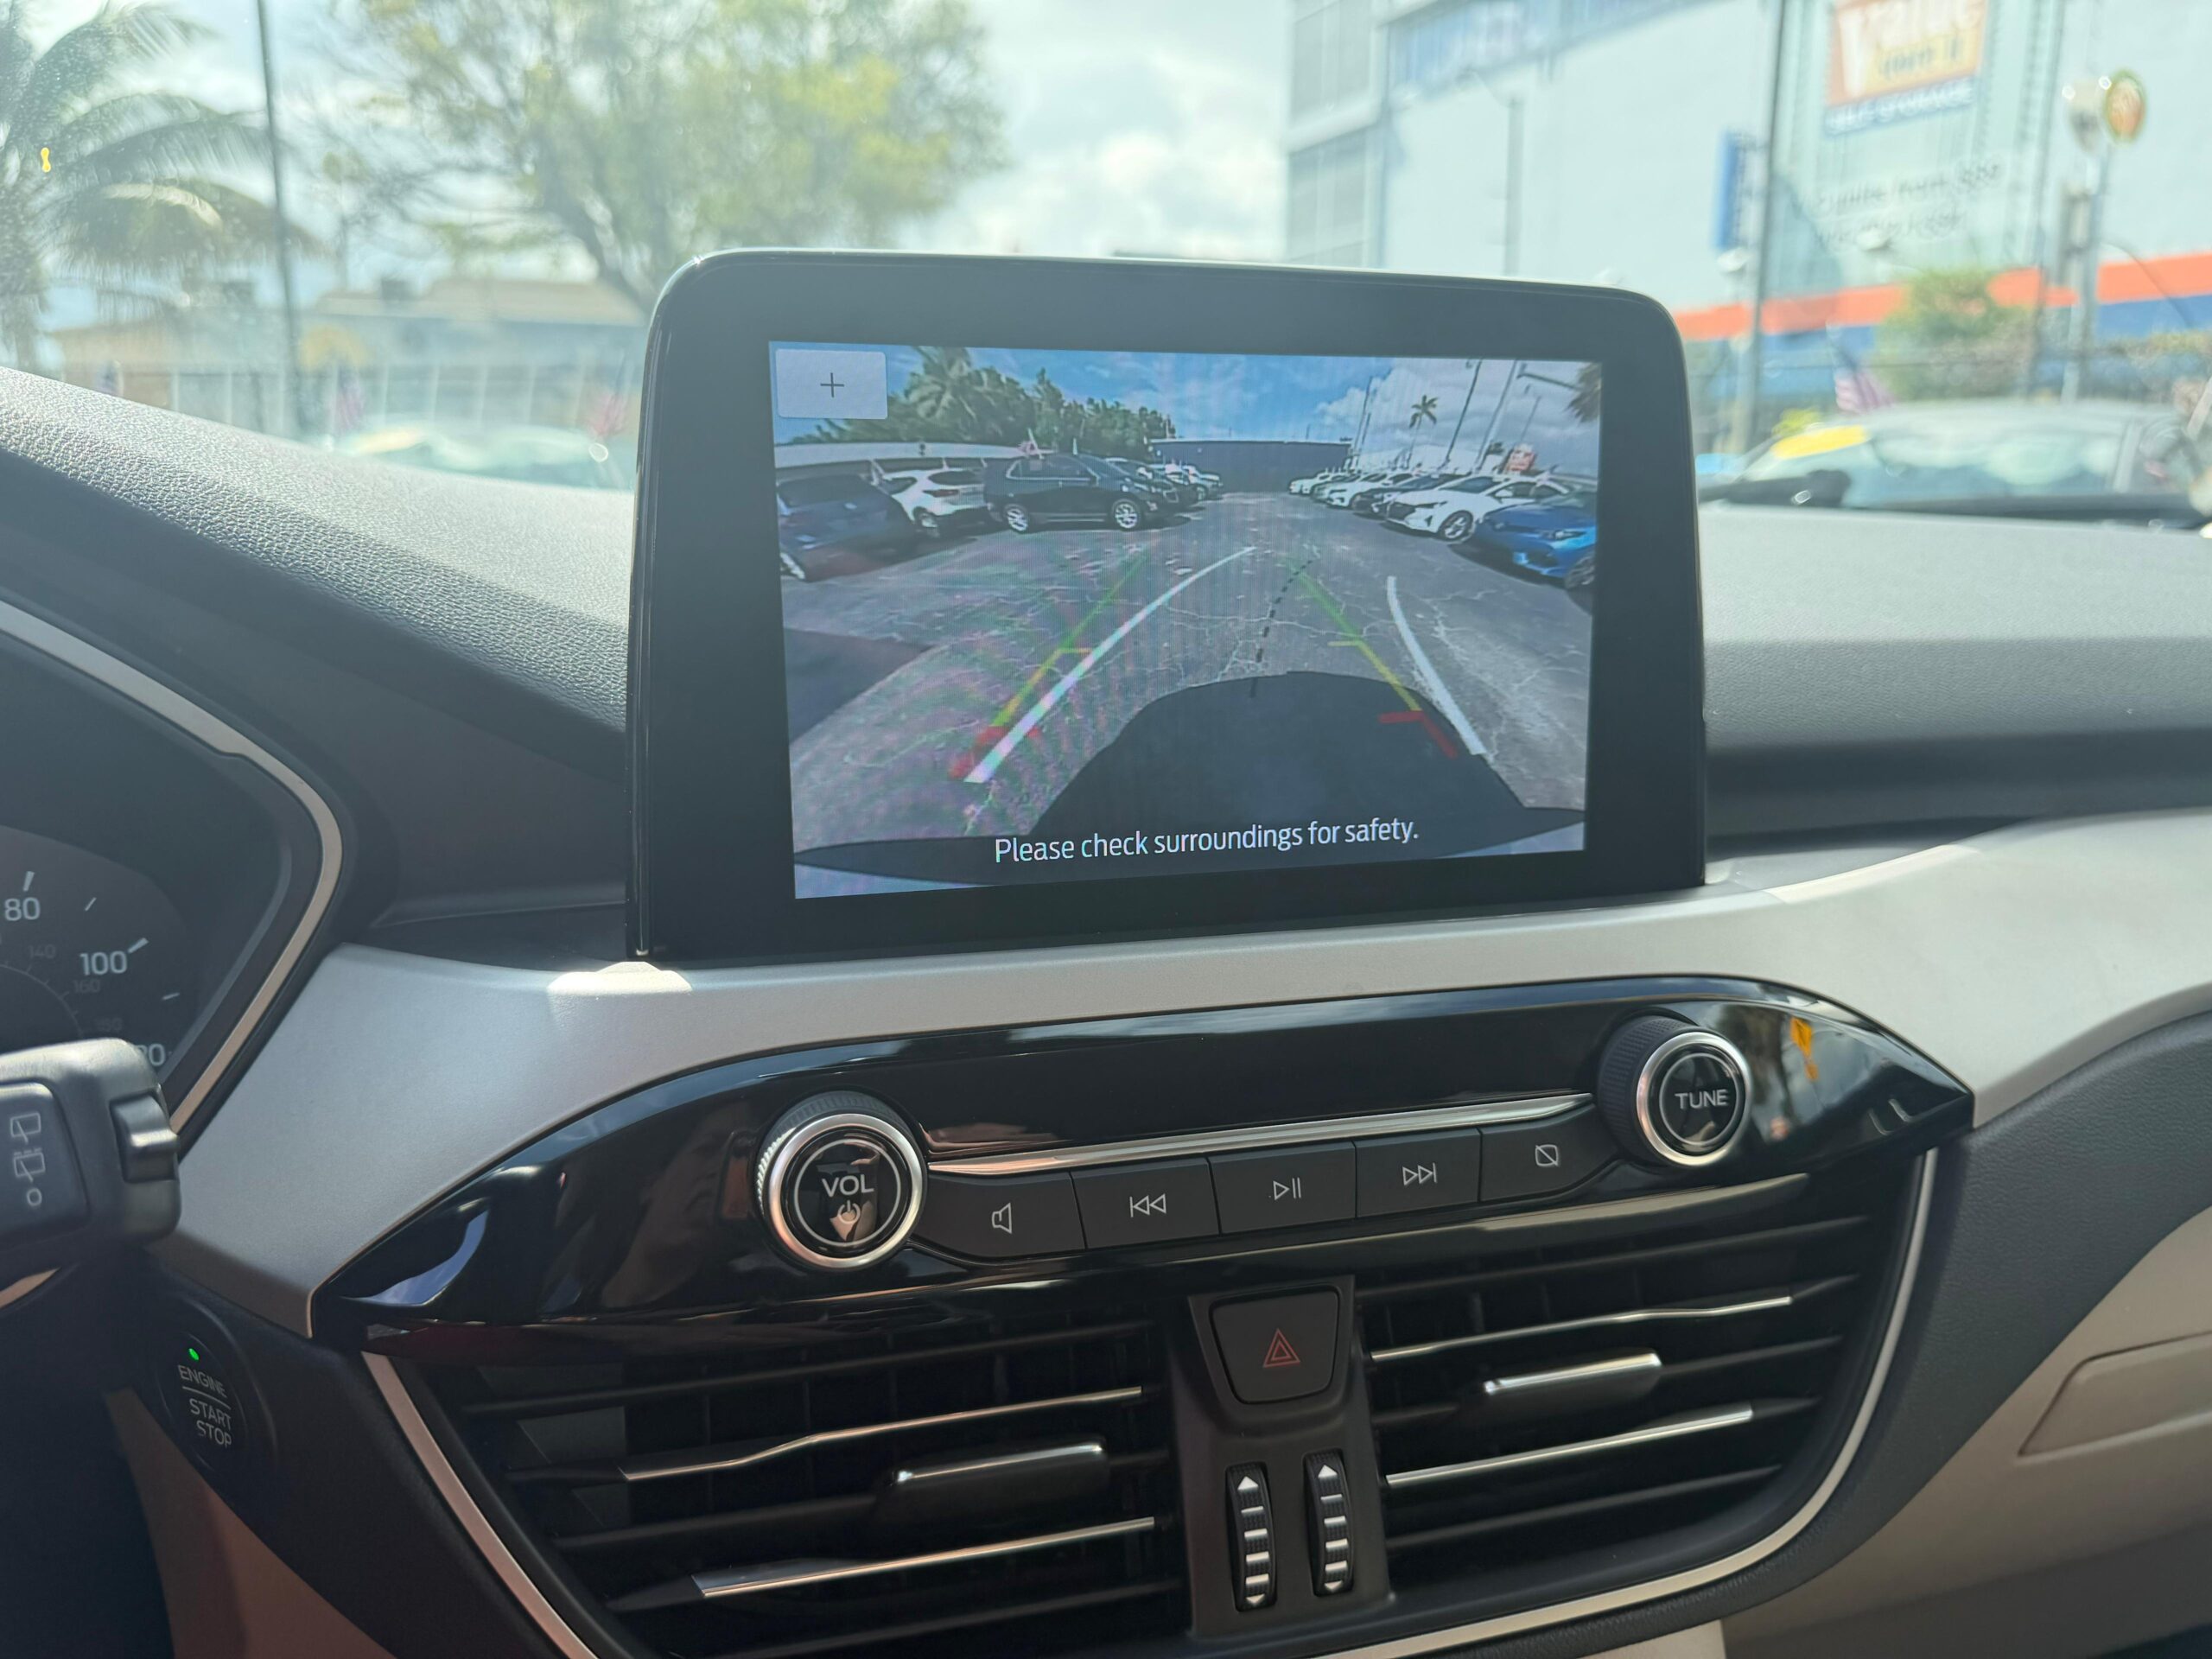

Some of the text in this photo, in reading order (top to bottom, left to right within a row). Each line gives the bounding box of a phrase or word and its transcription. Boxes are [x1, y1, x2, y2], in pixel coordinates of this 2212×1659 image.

[995, 817, 1420, 863] Please check surroundings for safety.
[3, 896, 41, 922] 80
[79, 950, 128, 976] 100
[1674, 1089, 1728, 1109] TUNE
[821, 1173, 874, 1198] VOL
[177, 1364, 228, 1398] ENGINE
[189, 1397, 232, 1431] START
[196, 1420, 232, 1448] STOP
